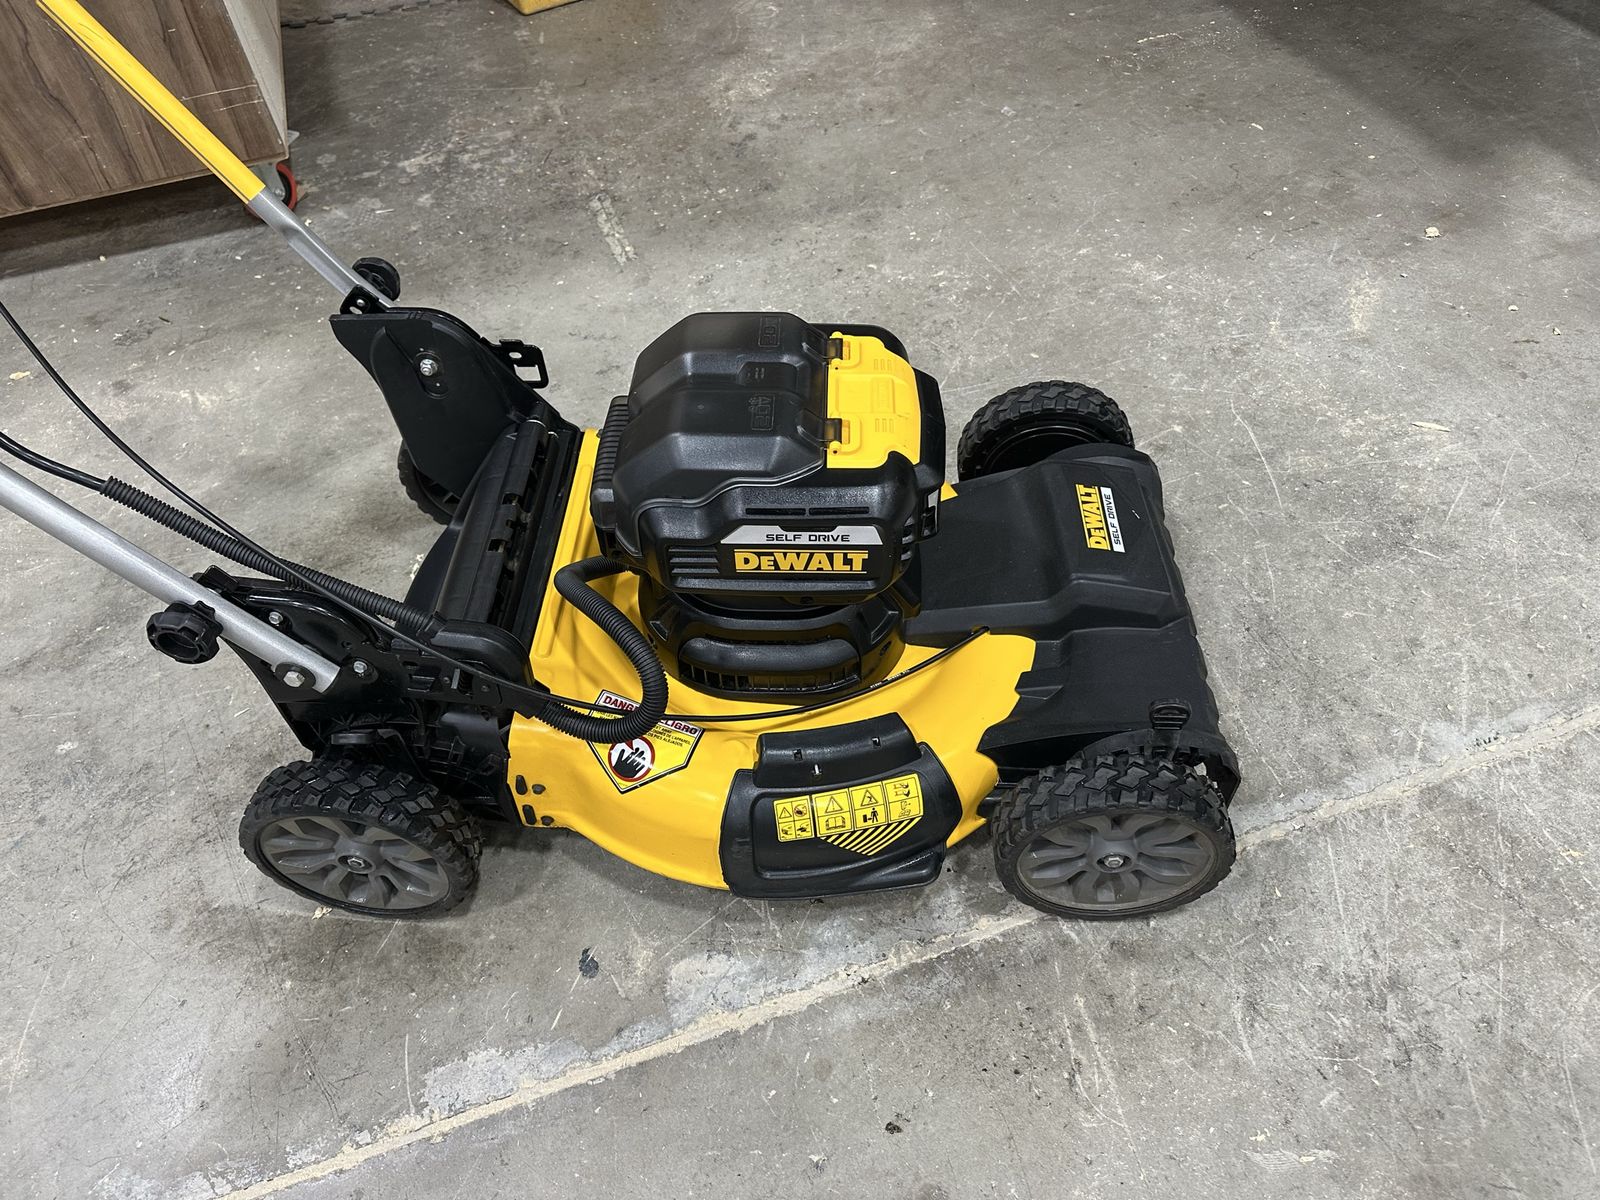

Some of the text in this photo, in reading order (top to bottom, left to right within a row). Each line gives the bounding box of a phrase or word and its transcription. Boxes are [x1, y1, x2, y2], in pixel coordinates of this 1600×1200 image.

[1104, 494, 1121, 545] SELF DRIVE
[766, 534, 850, 542] SELF DRIVE
[603, 696, 640, 712] DANG
[661, 720, 698, 735] LIGRO
